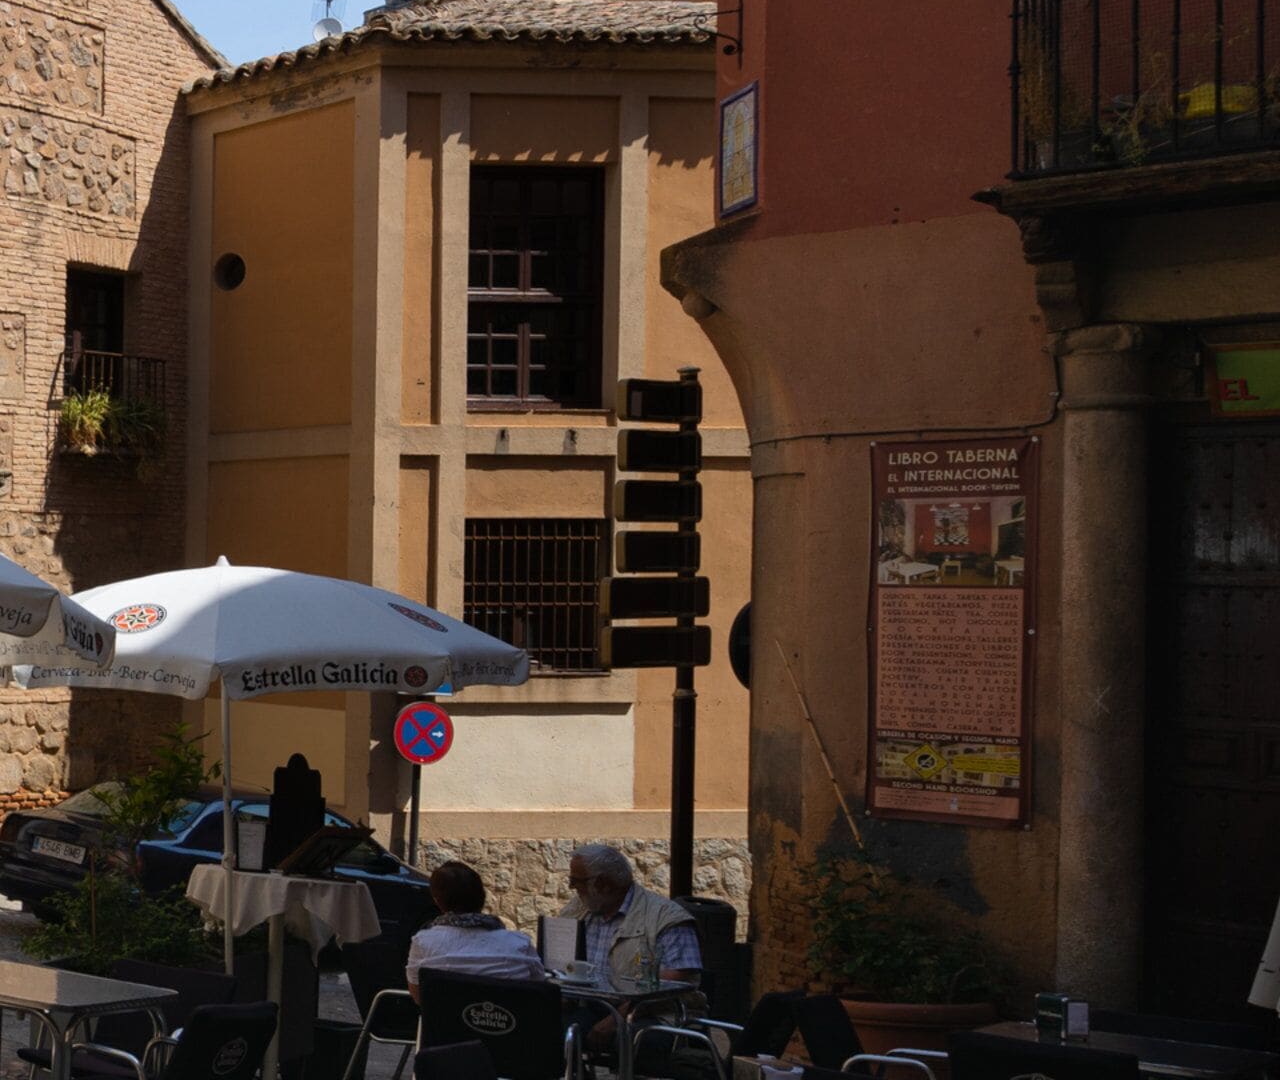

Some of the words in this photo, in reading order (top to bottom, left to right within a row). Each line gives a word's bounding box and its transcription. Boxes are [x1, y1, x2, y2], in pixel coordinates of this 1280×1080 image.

[888, 450, 939, 465] LIBRO
[946, 448, 1019, 463] TABERNA
[887, 473, 899, 482] EL
[903, 467, 1020, 482] INTERNACIONAL
[898, 485, 959, 493] INTERNACIONAL
[240, 666, 317, 692] Estrella
[321, 662, 398, 687] Galicia
[995, 737, 1018, 745] MANO
[892, 780, 923, 789] SECOND
[925, 783, 948, 791] HAND
[949, 785, 997, 796] BOOKSHOP
